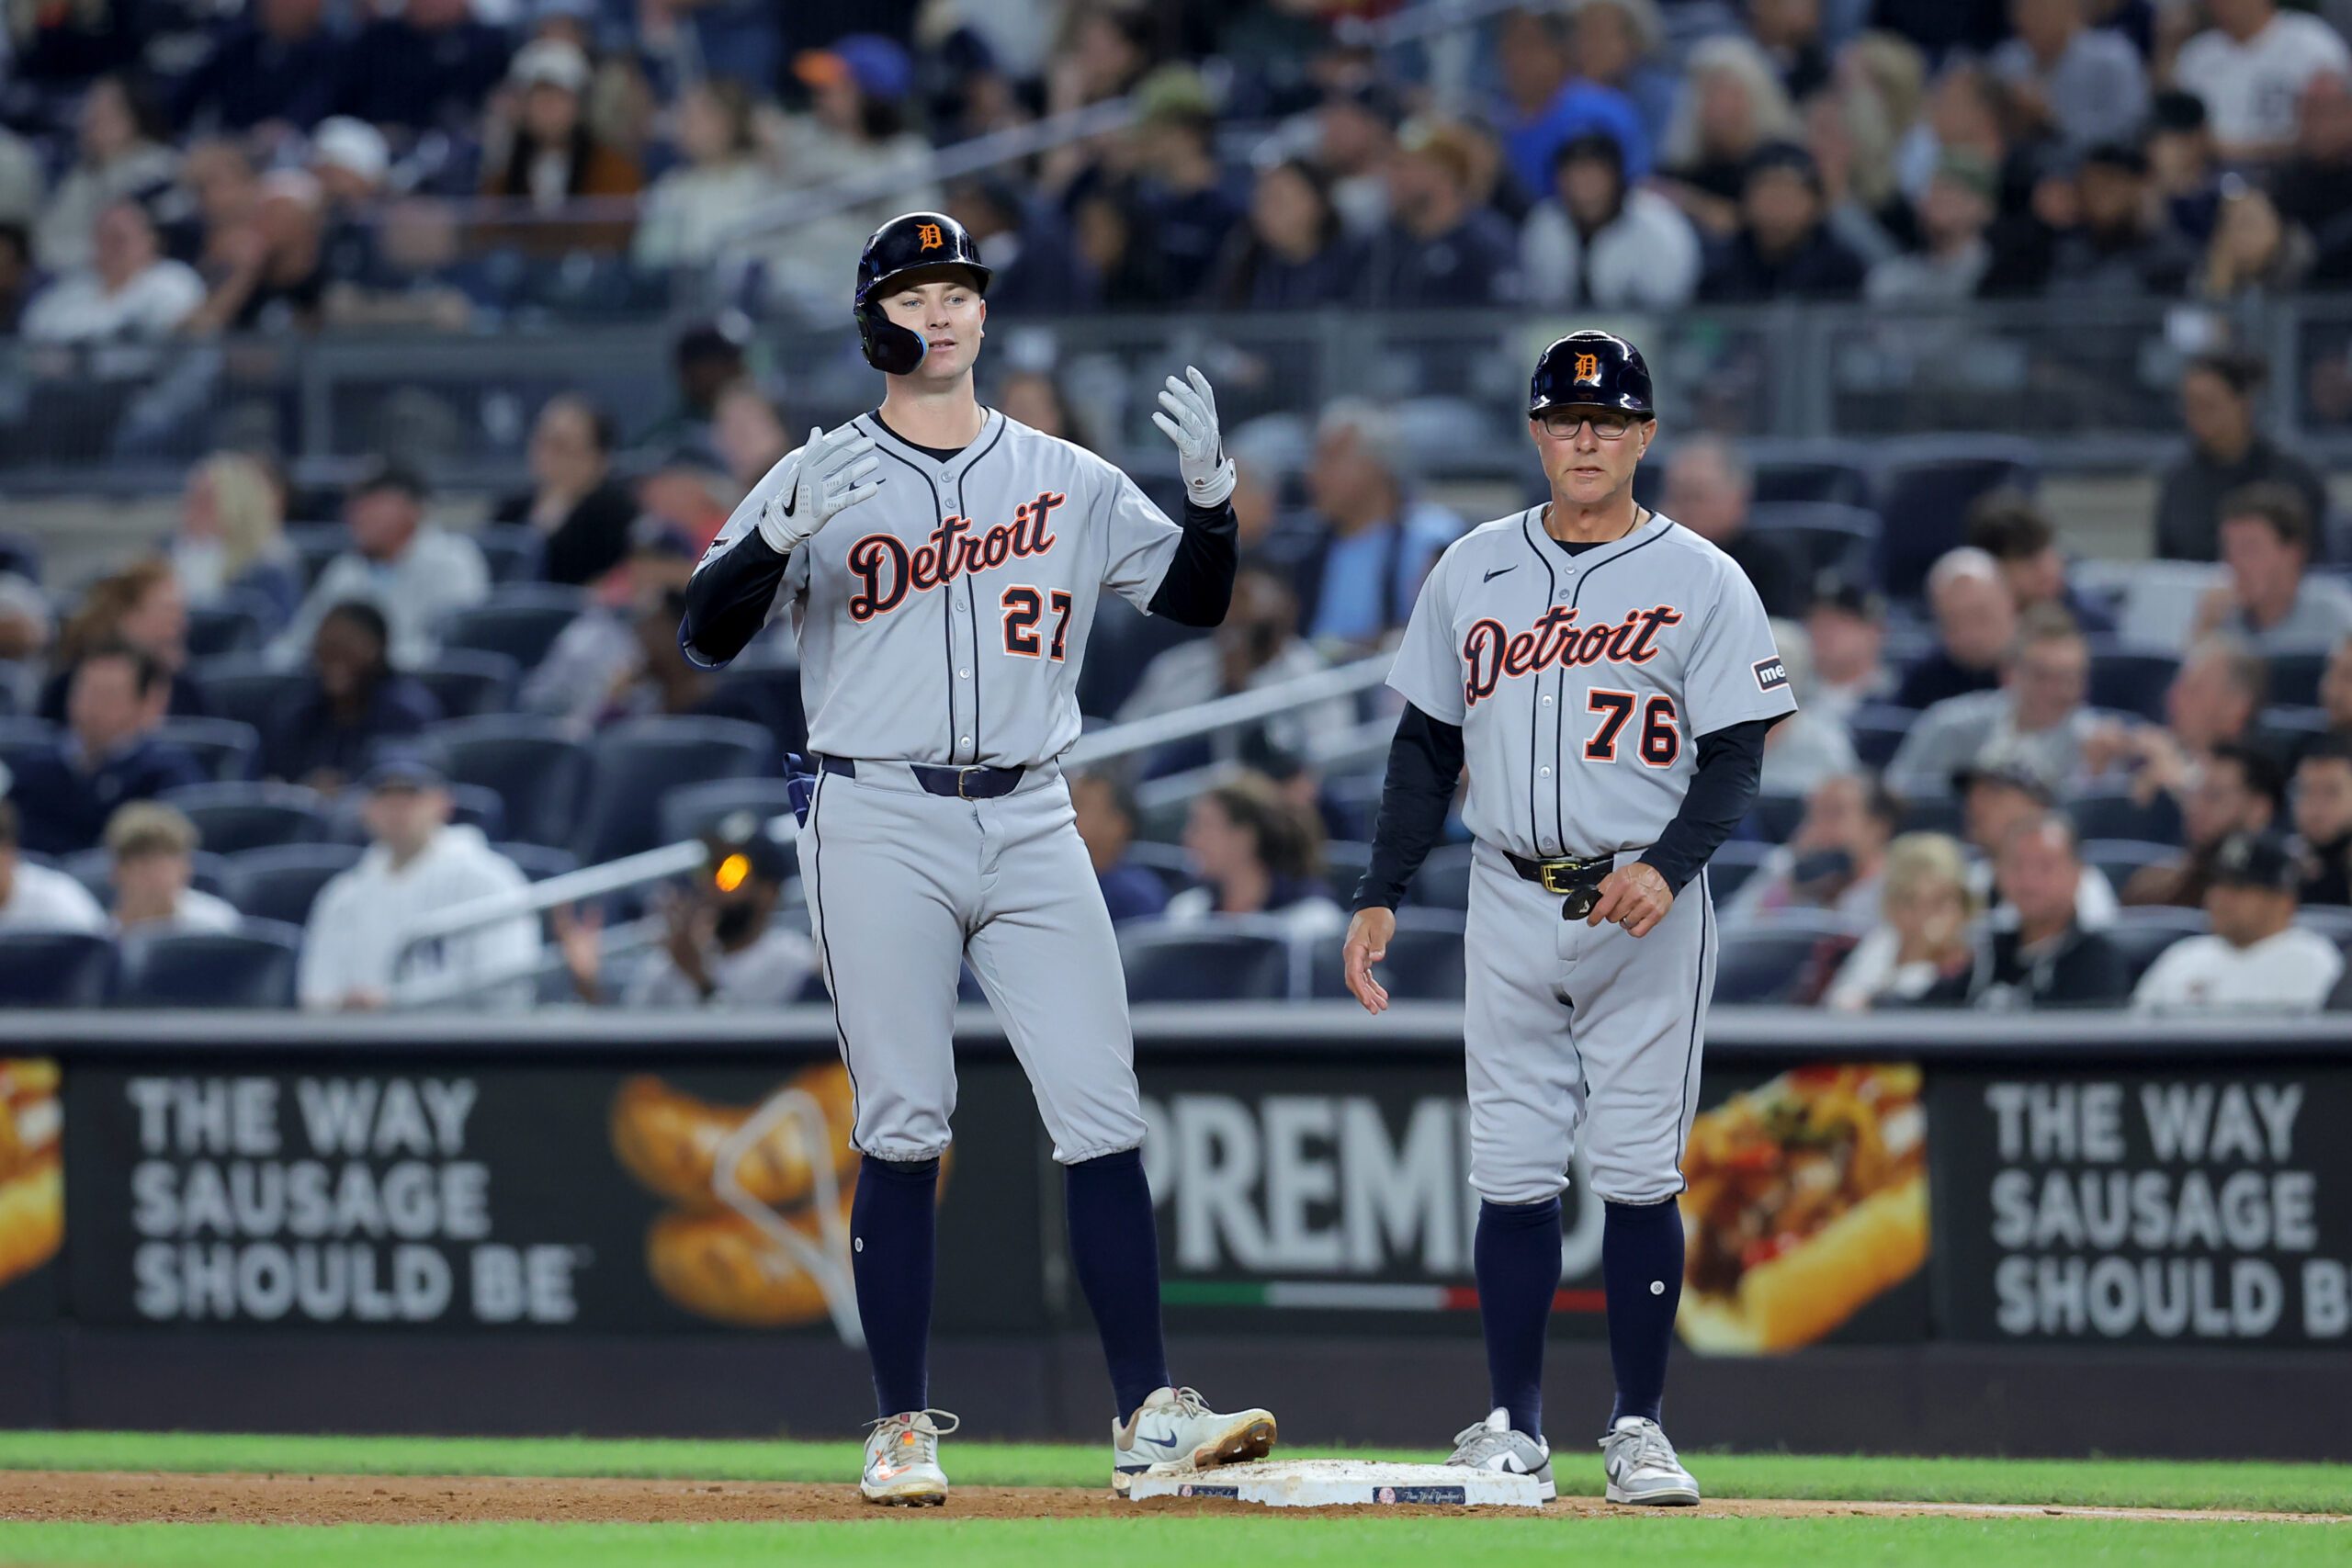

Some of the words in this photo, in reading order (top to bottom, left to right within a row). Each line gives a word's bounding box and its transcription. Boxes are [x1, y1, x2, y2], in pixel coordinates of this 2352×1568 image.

[916, 223, 944, 253] D
[1573, 352, 1599, 386] D
[847, 491, 1066, 623] Detroit
[1000, 583, 1073, 663] 27
[1463, 604, 1683, 707] Detroit
[1581, 686, 1680, 770] 76
[127, 1078, 279, 1156] THE
[295, 1078, 477, 1156] WAY
[1985, 1082, 2126, 1163] THE
[2140, 1082, 2304, 1163] WAY
[131, 1160, 492, 1239] SAUSAGE
[1991, 1168, 2318, 1251] SAUSAGE
[133, 1241, 454, 1321] SHOULD
[1995, 1255, 2284, 1337] SHOULD
[2301, 1258, 2352, 1338] B
